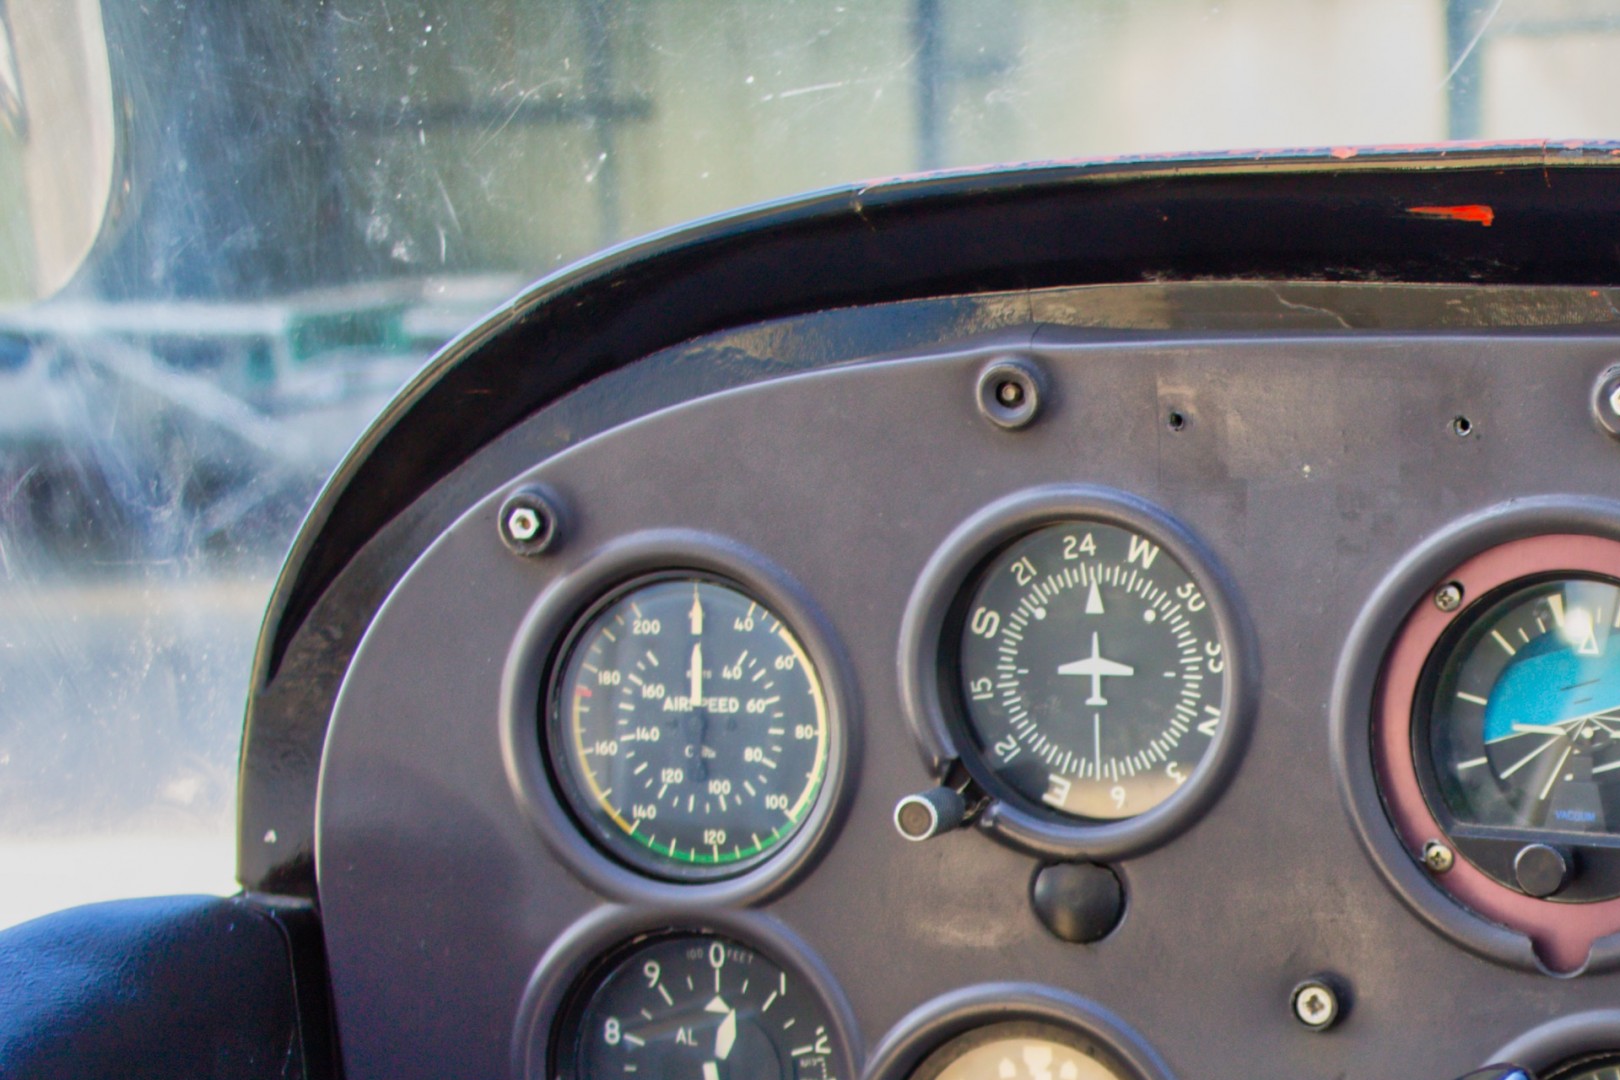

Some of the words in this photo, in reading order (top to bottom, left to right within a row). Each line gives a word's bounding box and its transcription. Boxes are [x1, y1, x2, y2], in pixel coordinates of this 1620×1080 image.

[1063, 533, 1096, 559] 24
[1128, 535, 1160, 569] W
[1010, 556, 1037, 586] 21
[1176, 582, 1206, 612] 30
[632, 620, 660, 634] 200
[734, 618, 753, 631] 40
[971, 607, 1000, 639] S
[775, 656, 793, 669] 60
[599, 671, 620, 685] 180
[723, 666, 742, 679] 40
[642, 685, 665, 699] 160
[970, 677, 993, 700] 15
[747, 698, 765, 712] 60
[1197, 705, 1220, 736] N
[636, 728, 659, 741] 140
[795, 726, 813, 739] 80
[595, 742, 617, 756] 160
[744, 748, 762, 762] 80
[994, 734, 1021, 764] 12
[662, 769, 683, 784] 120
[708, 780, 730, 794] 100
[1042, 774, 1071, 807] E
[766, 795, 787, 809] 100
[632, 806, 656, 819] 140
[704, 831, 725, 844] 120
[709, 942, 725, 968] 0
[644, 961, 660, 988] 9
[605, 1017, 620, 1045] 8
